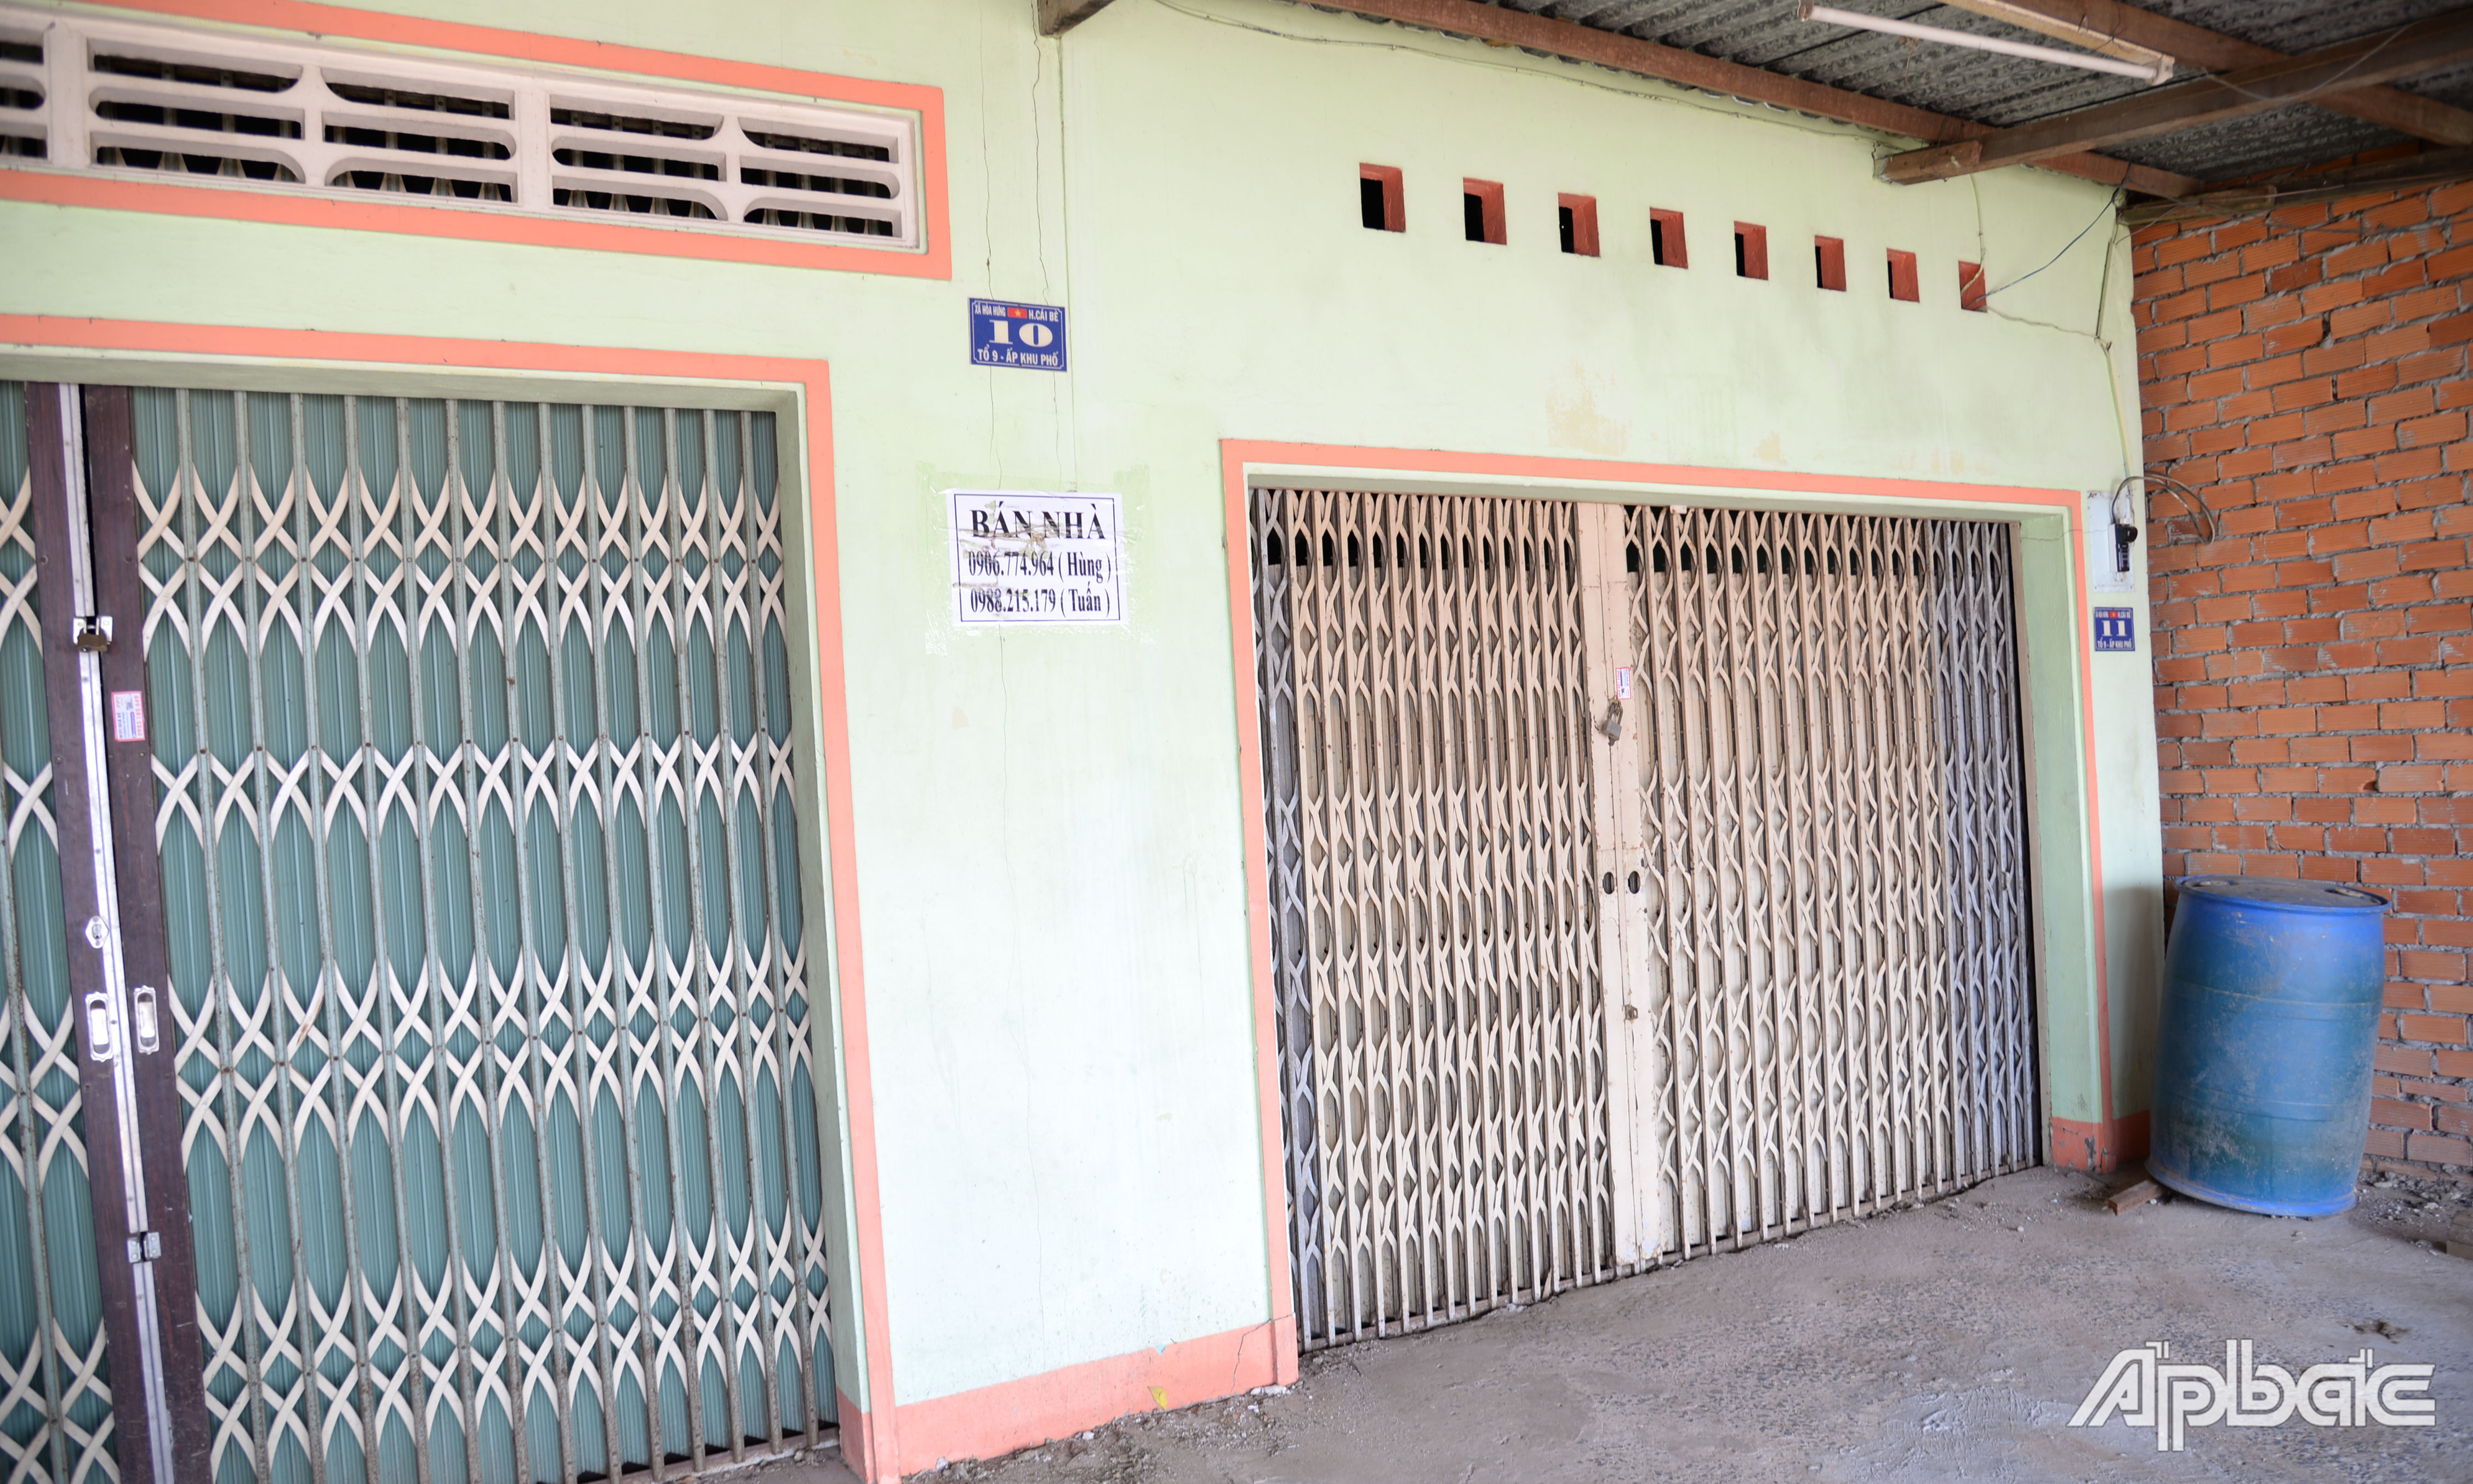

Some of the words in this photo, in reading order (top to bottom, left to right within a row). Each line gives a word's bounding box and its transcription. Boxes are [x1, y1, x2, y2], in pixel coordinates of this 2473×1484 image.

[982, 302, 992, 316] HÒA
[1028, 308, 1047, 322] H.CÁI
[1049, 309, 1059, 322] BÈ
[989, 319, 1053, 347] 10
[977, 344, 990, 361] TỔ
[992, 350, 998, 362] 9
[1006, 347, 1018, 363] ẤP
[1020, 352, 1038, 366] KHU
[1040, 351, 1059, 366] PHỐ
[970, 501, 1033, 539] BÁN
[1042, 503, 1106, 539] NHÀ
[968, 551, 1054, 576] 0906.774.964
[1067, 551, 1103, 583] Hùng
[971, 589, 1056, 613] 0988.215.179
[1068, 581, 1102, 612] Tuấn
[2101, 620, 2127, 636] 11
